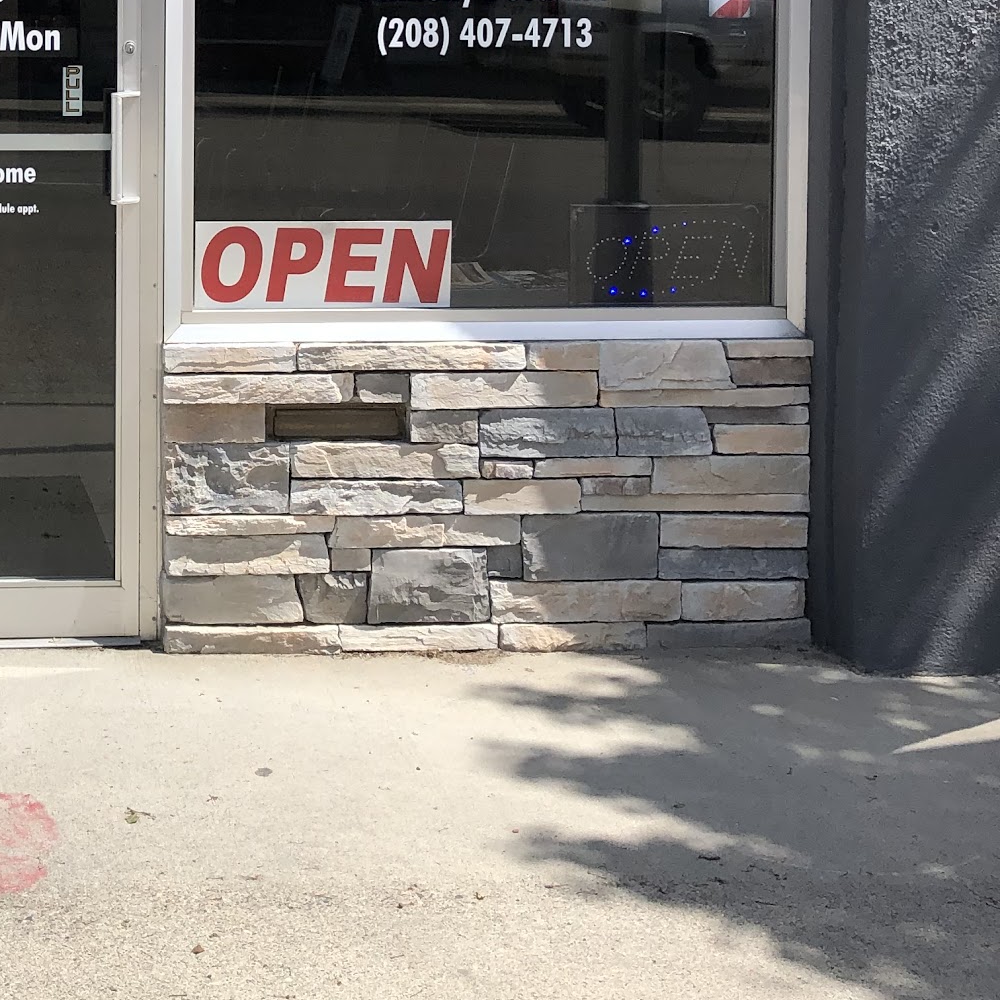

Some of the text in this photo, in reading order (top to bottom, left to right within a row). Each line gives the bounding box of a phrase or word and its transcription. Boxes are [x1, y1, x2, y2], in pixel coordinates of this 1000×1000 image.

[377, 16, 593, 56] (208) 407-4713
[65, 66, 80, 113] PULL
[17, 203, 40, 216] appt.
[200, 226, 450, 304] OPEN
[586, 235, 755, 280] OPEN
